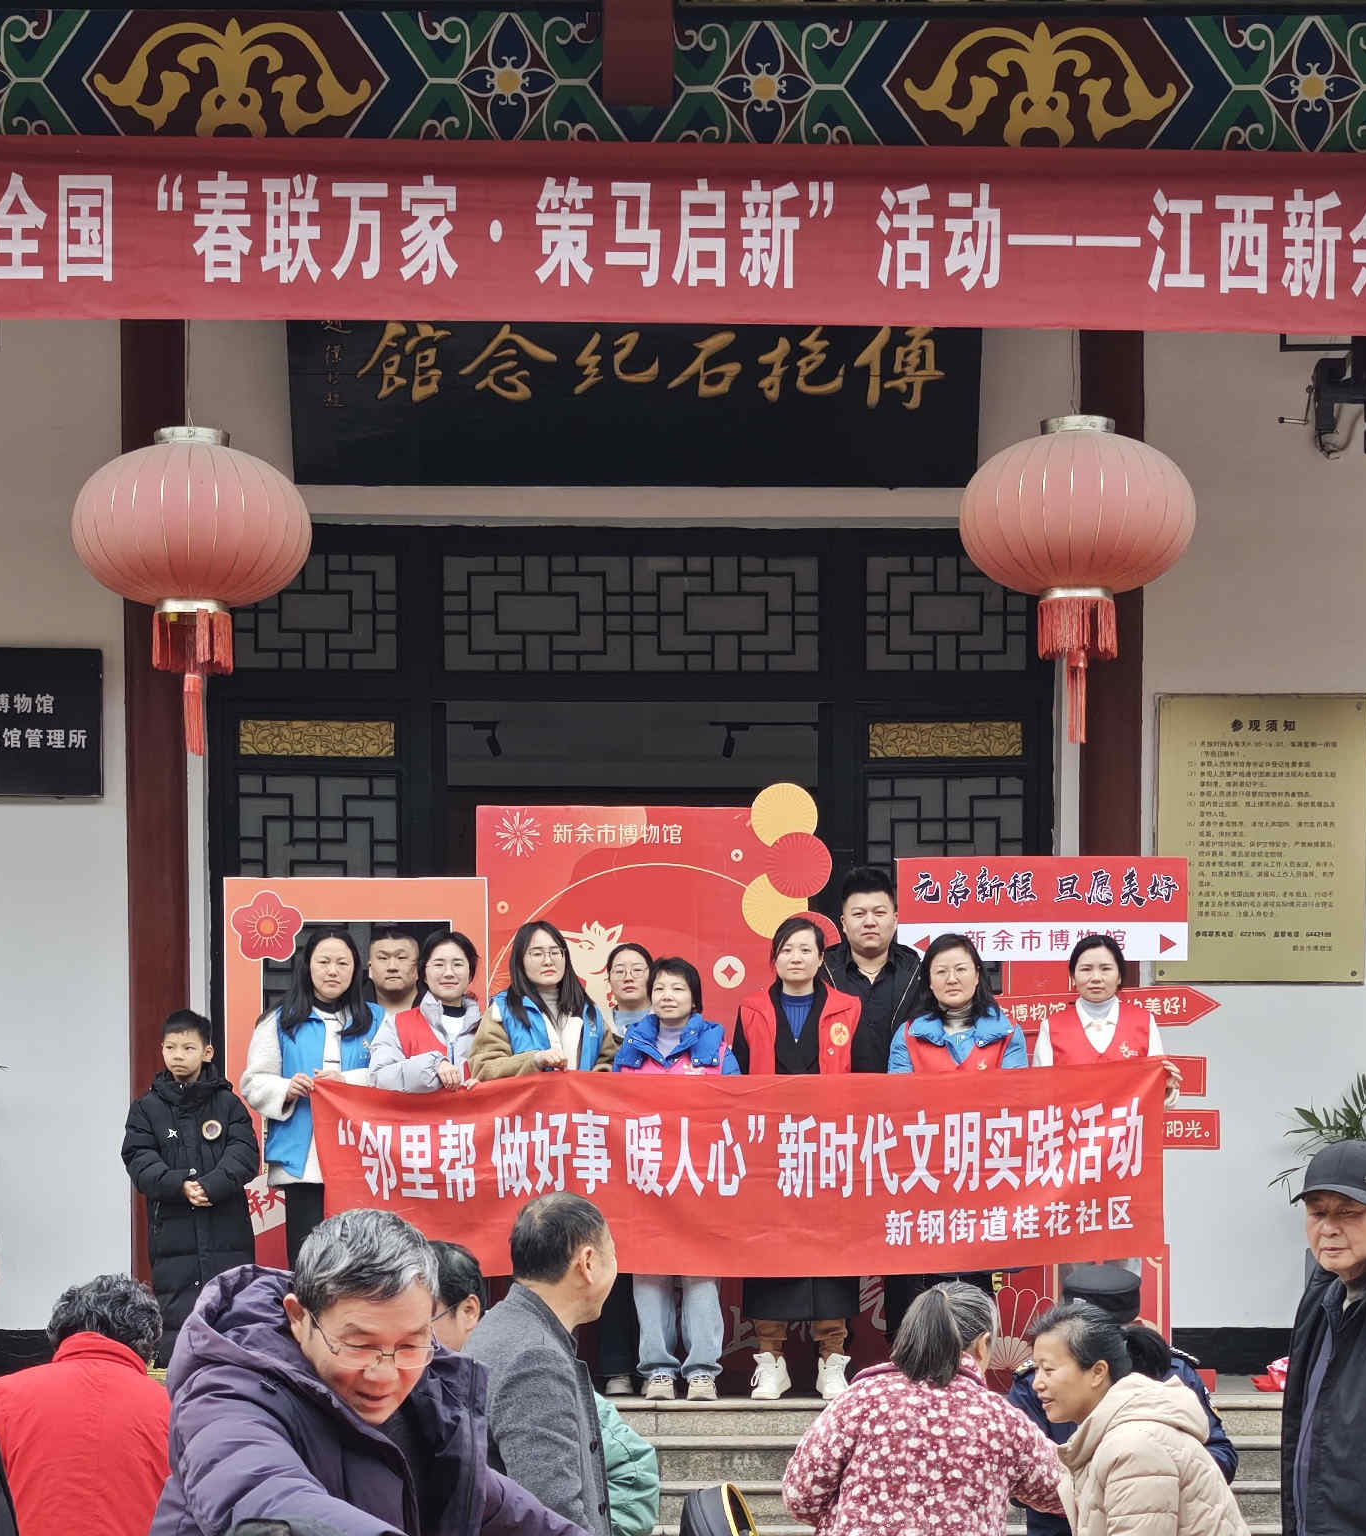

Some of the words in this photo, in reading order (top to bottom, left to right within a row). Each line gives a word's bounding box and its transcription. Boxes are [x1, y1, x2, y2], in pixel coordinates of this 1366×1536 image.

[1231, 719, 1297, 732] 参观须知
[552, 823, 683, 846] 新余市博物馆
[912, 866, 1037, 907] 元启新程
[1054, 866, 1179, 907] 旦愿美好
[491, 1108, 612, 1198] 做好事
[884, 1195, 1135, 1248] 新钢街道桂花社区
